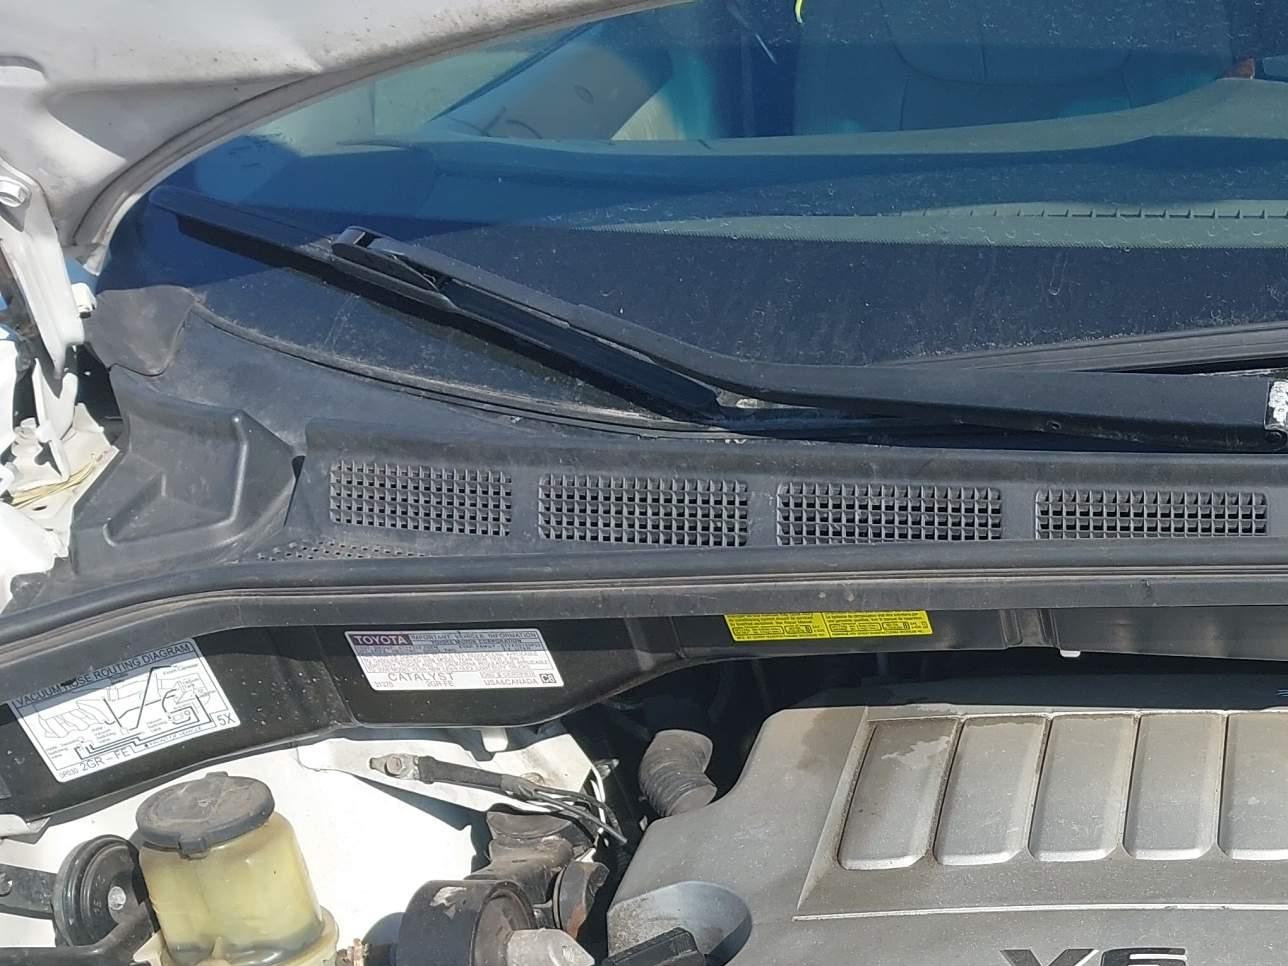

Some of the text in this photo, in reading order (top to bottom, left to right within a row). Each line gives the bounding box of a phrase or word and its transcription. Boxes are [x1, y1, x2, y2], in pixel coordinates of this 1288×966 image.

[353, 635, 408, 645] TOYOTA
[17, 683, 63, 706] VACUUM
[94, 657, 142, 681] ROUTING
[141, 643, 191, 665] DIAGRAM
[387, 671, 455, 682] CATALYST
[216, 711, 237, 727] 5X
